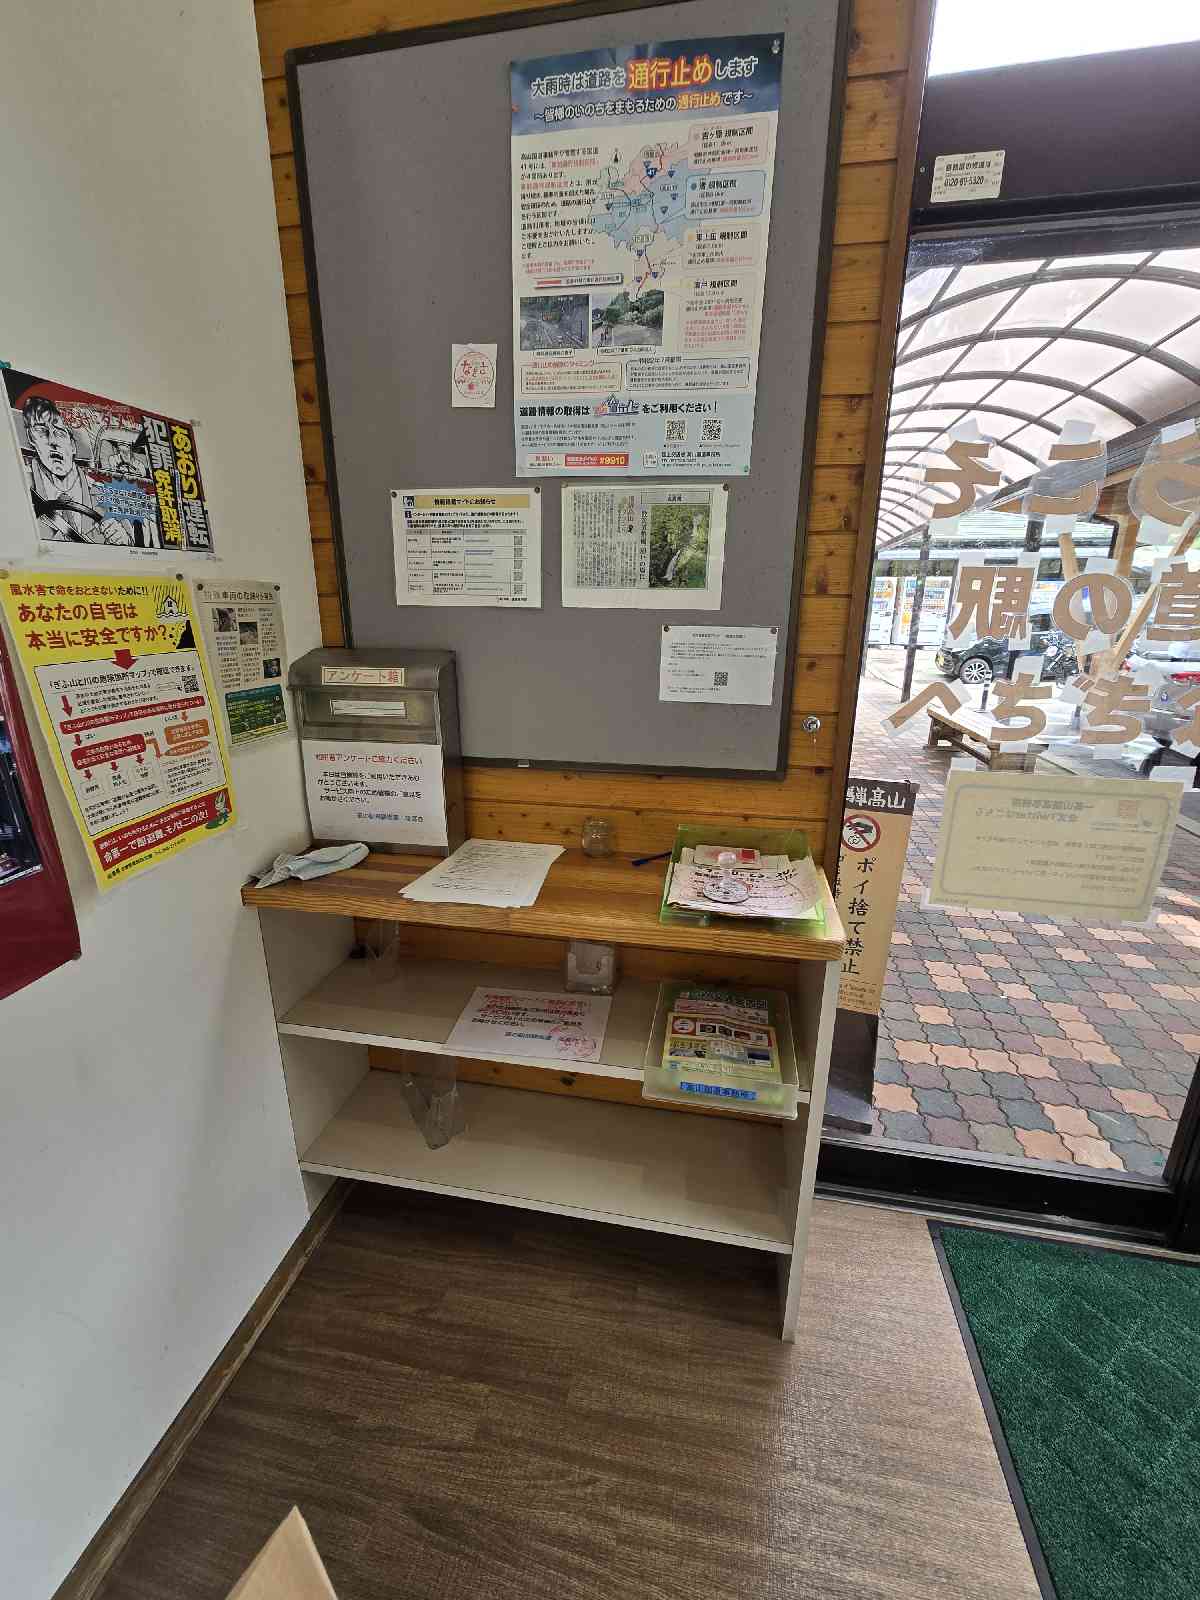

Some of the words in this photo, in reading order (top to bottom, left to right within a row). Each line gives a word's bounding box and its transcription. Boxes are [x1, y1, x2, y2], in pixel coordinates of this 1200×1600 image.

[17, 602, 139, 623] あなたの自宅は
[24, 624, 168, 651] 本当に安全ですか?
[326, 670, 401, 683] アンケート箱
[840, 856, 879, 976] ポイ捨て禁止
